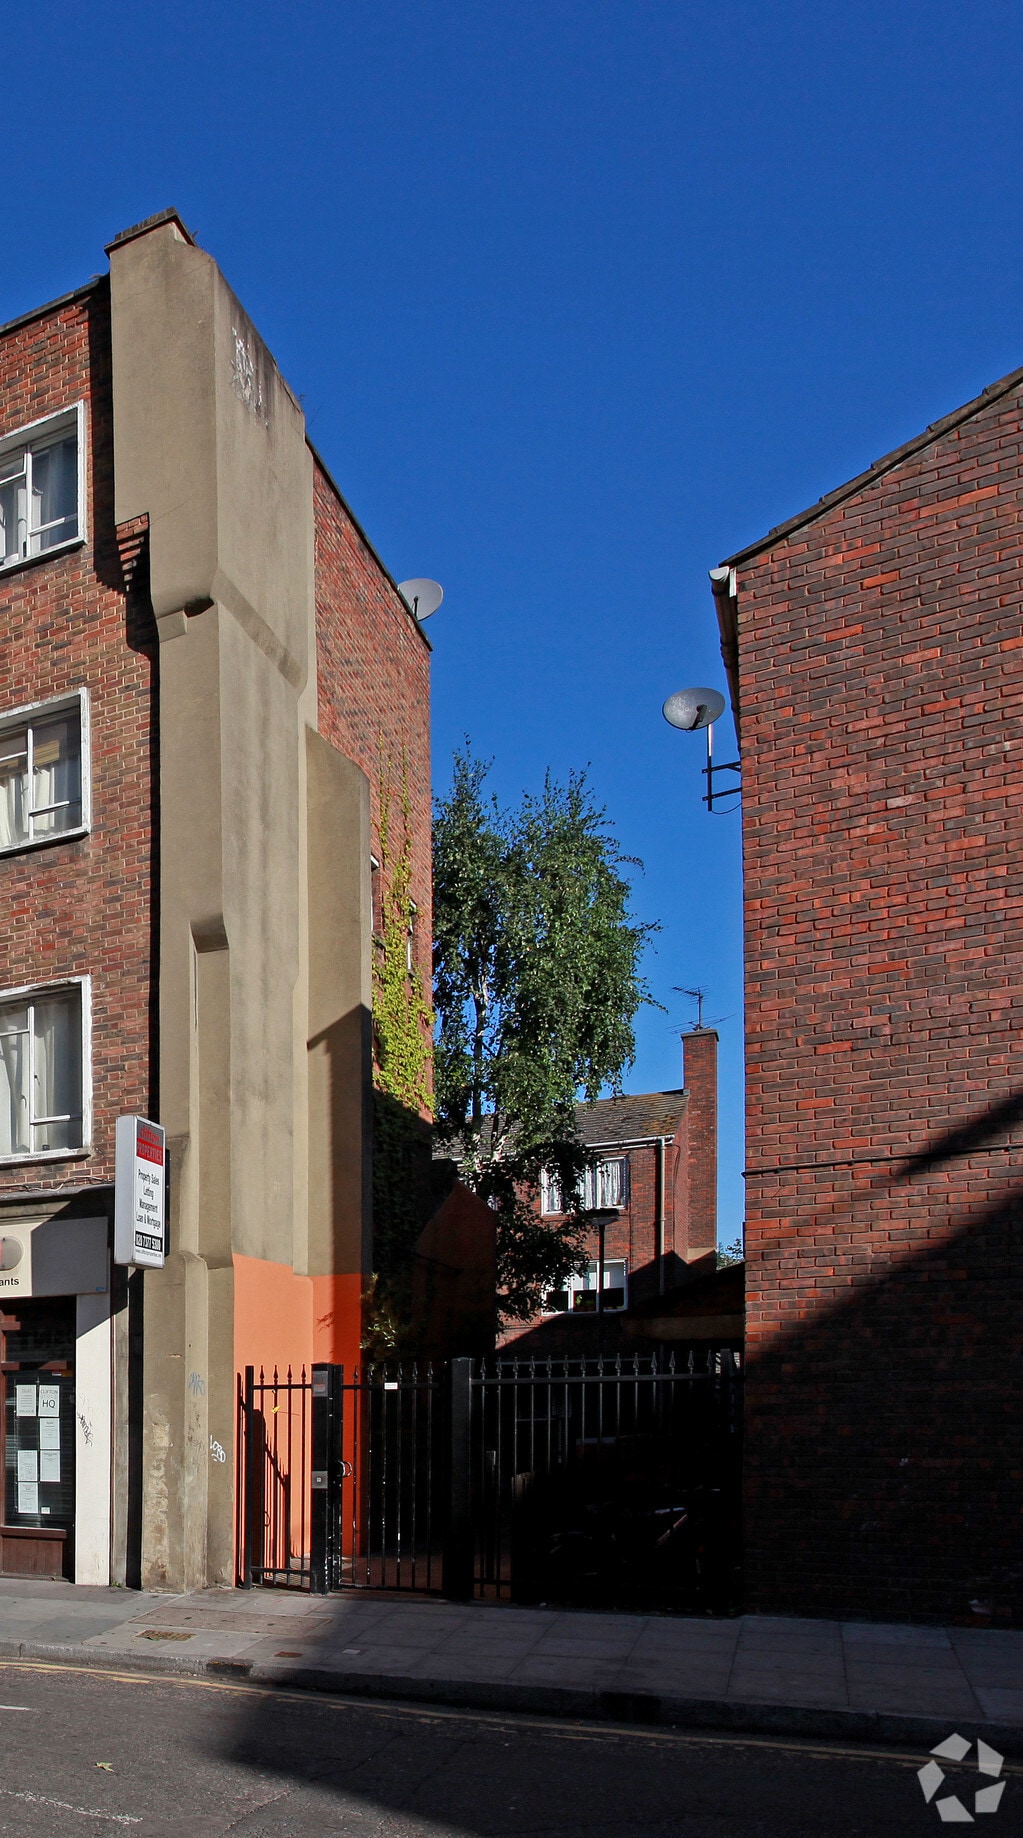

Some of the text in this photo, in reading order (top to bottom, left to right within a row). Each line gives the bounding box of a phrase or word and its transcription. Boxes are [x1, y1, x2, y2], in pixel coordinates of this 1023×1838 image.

[138, 1168, 160, 1185] Property Sales
[139, 1198, 158, 1213] Management
[136, 1212, 144, 1224] Loan
[147, 1214, 161, 1230] Mortgage
[42, 1399, 56, 1408] HQ
